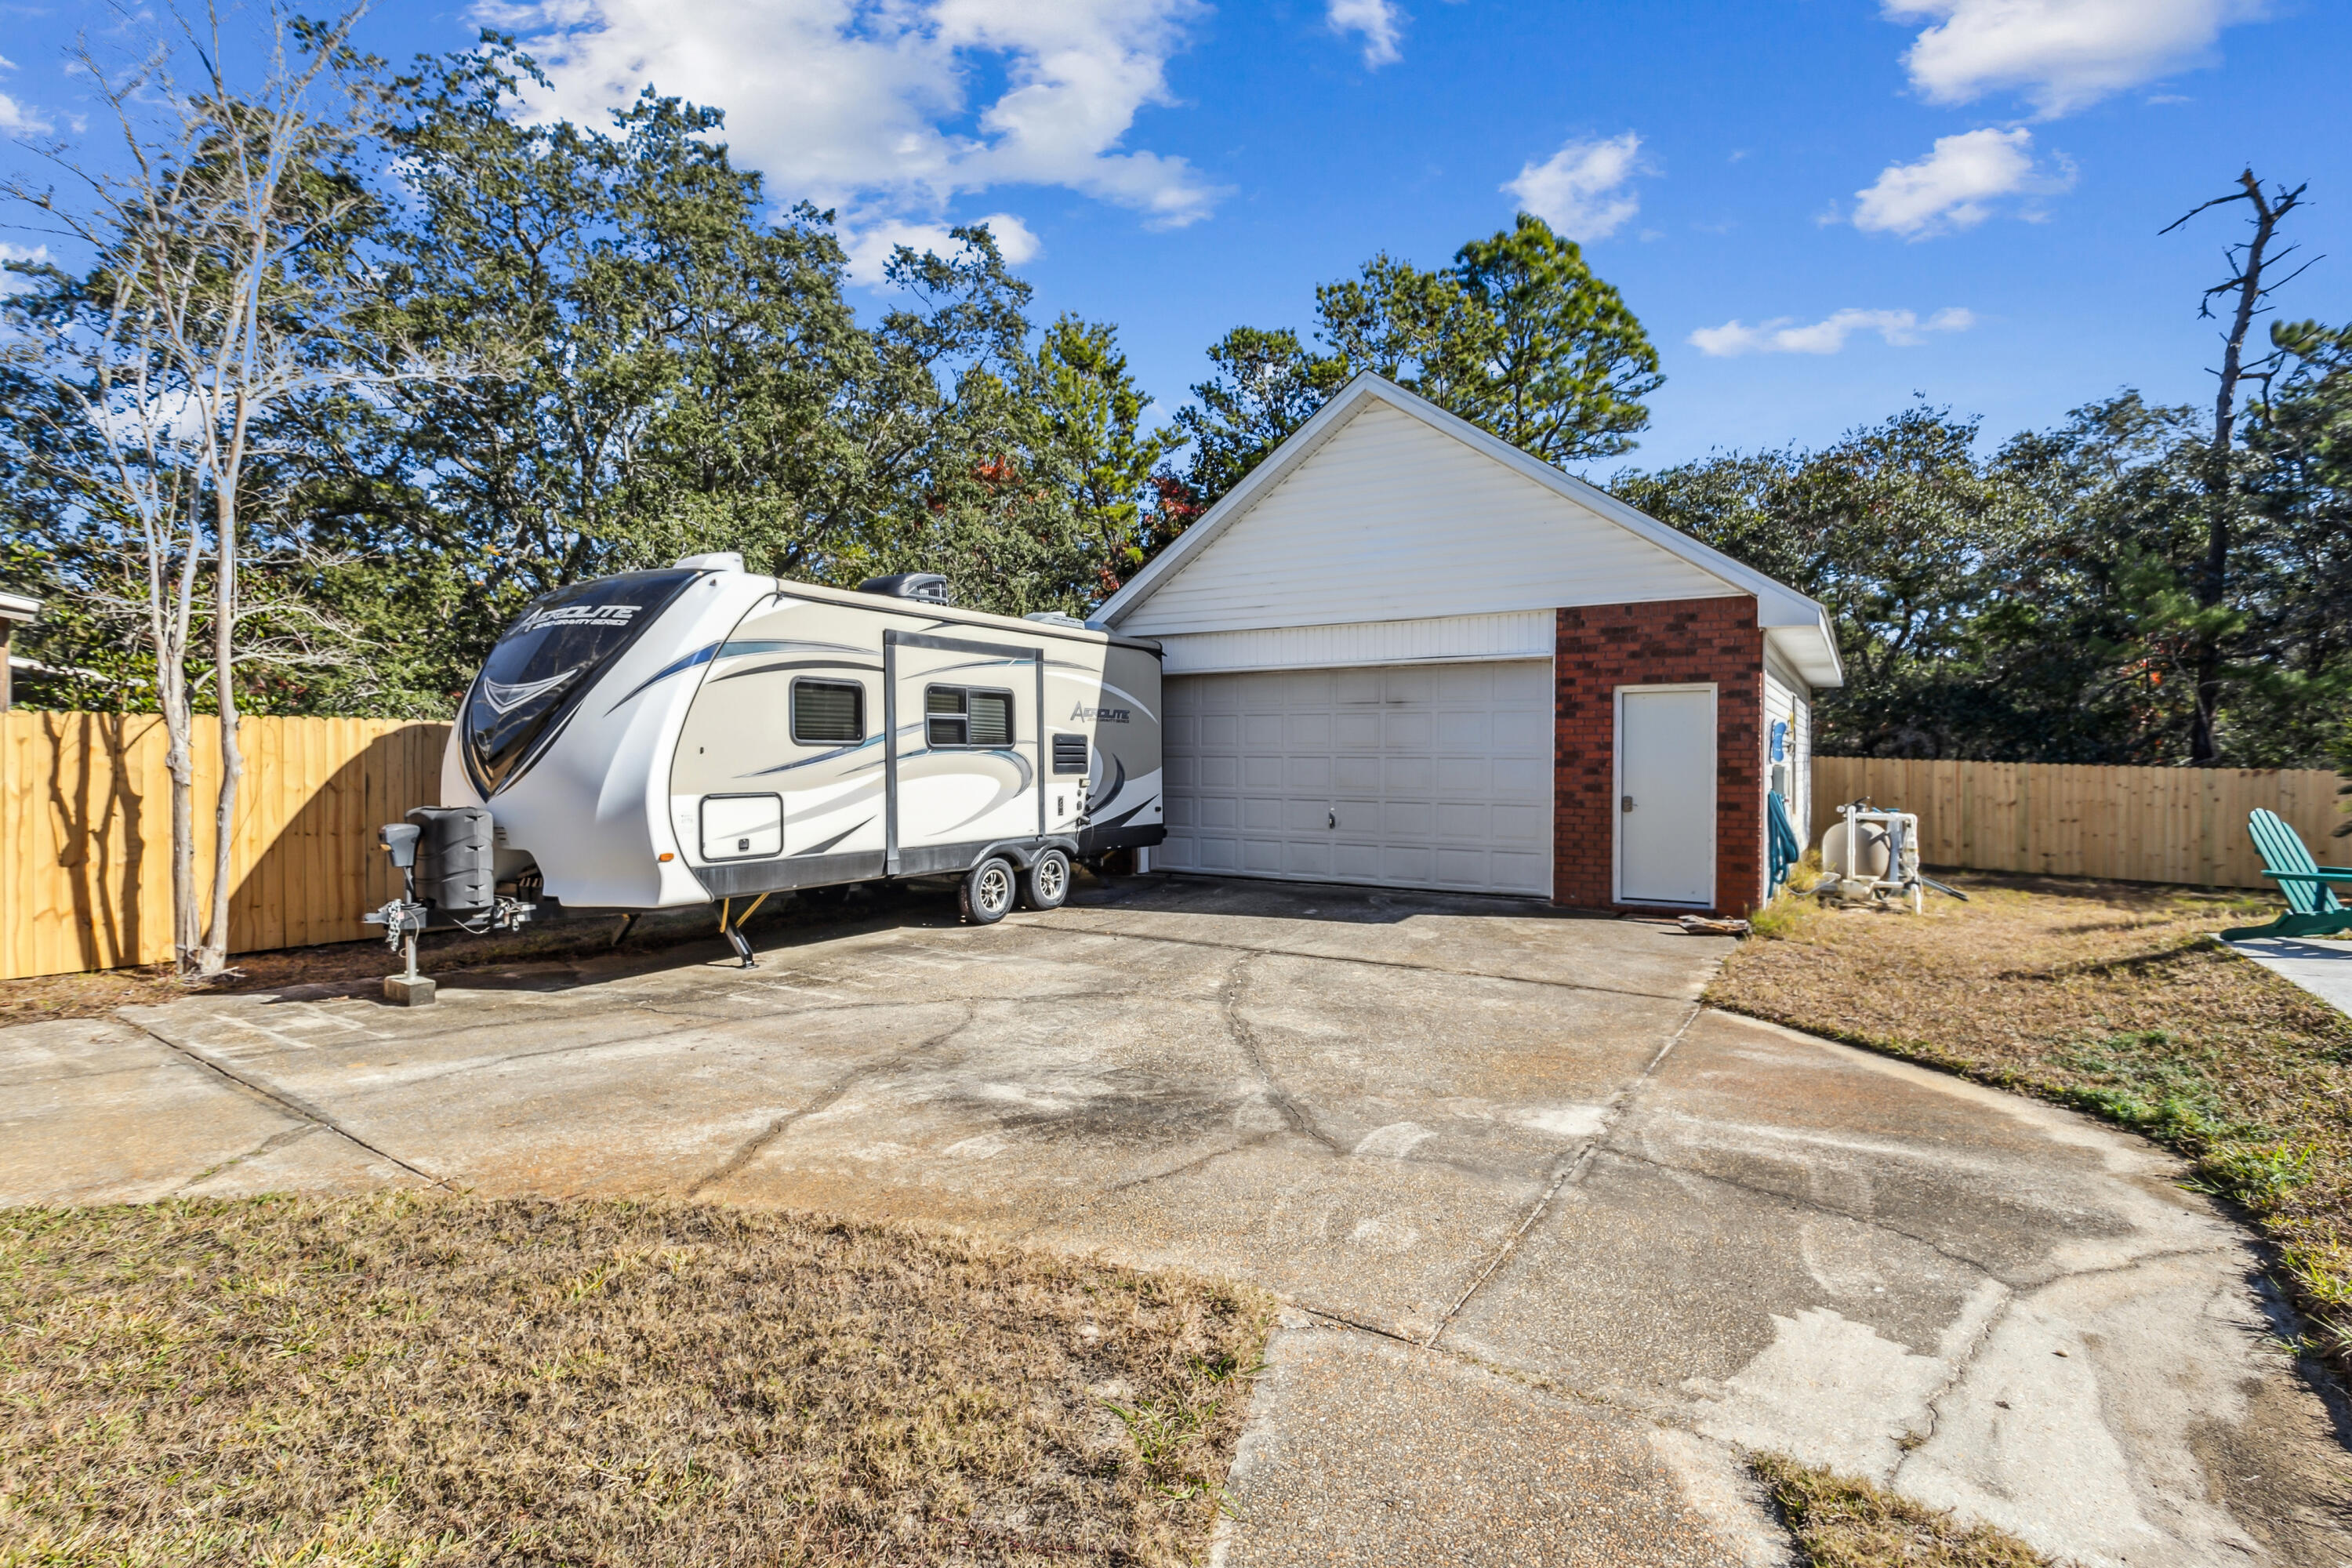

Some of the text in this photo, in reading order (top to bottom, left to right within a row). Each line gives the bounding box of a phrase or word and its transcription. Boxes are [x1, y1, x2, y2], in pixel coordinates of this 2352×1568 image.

[509, 605, 643, 636] AEROLITE
[590, 618, 629, 626] SERIES
[1069, 700, 1131, 723] AEROLITE
